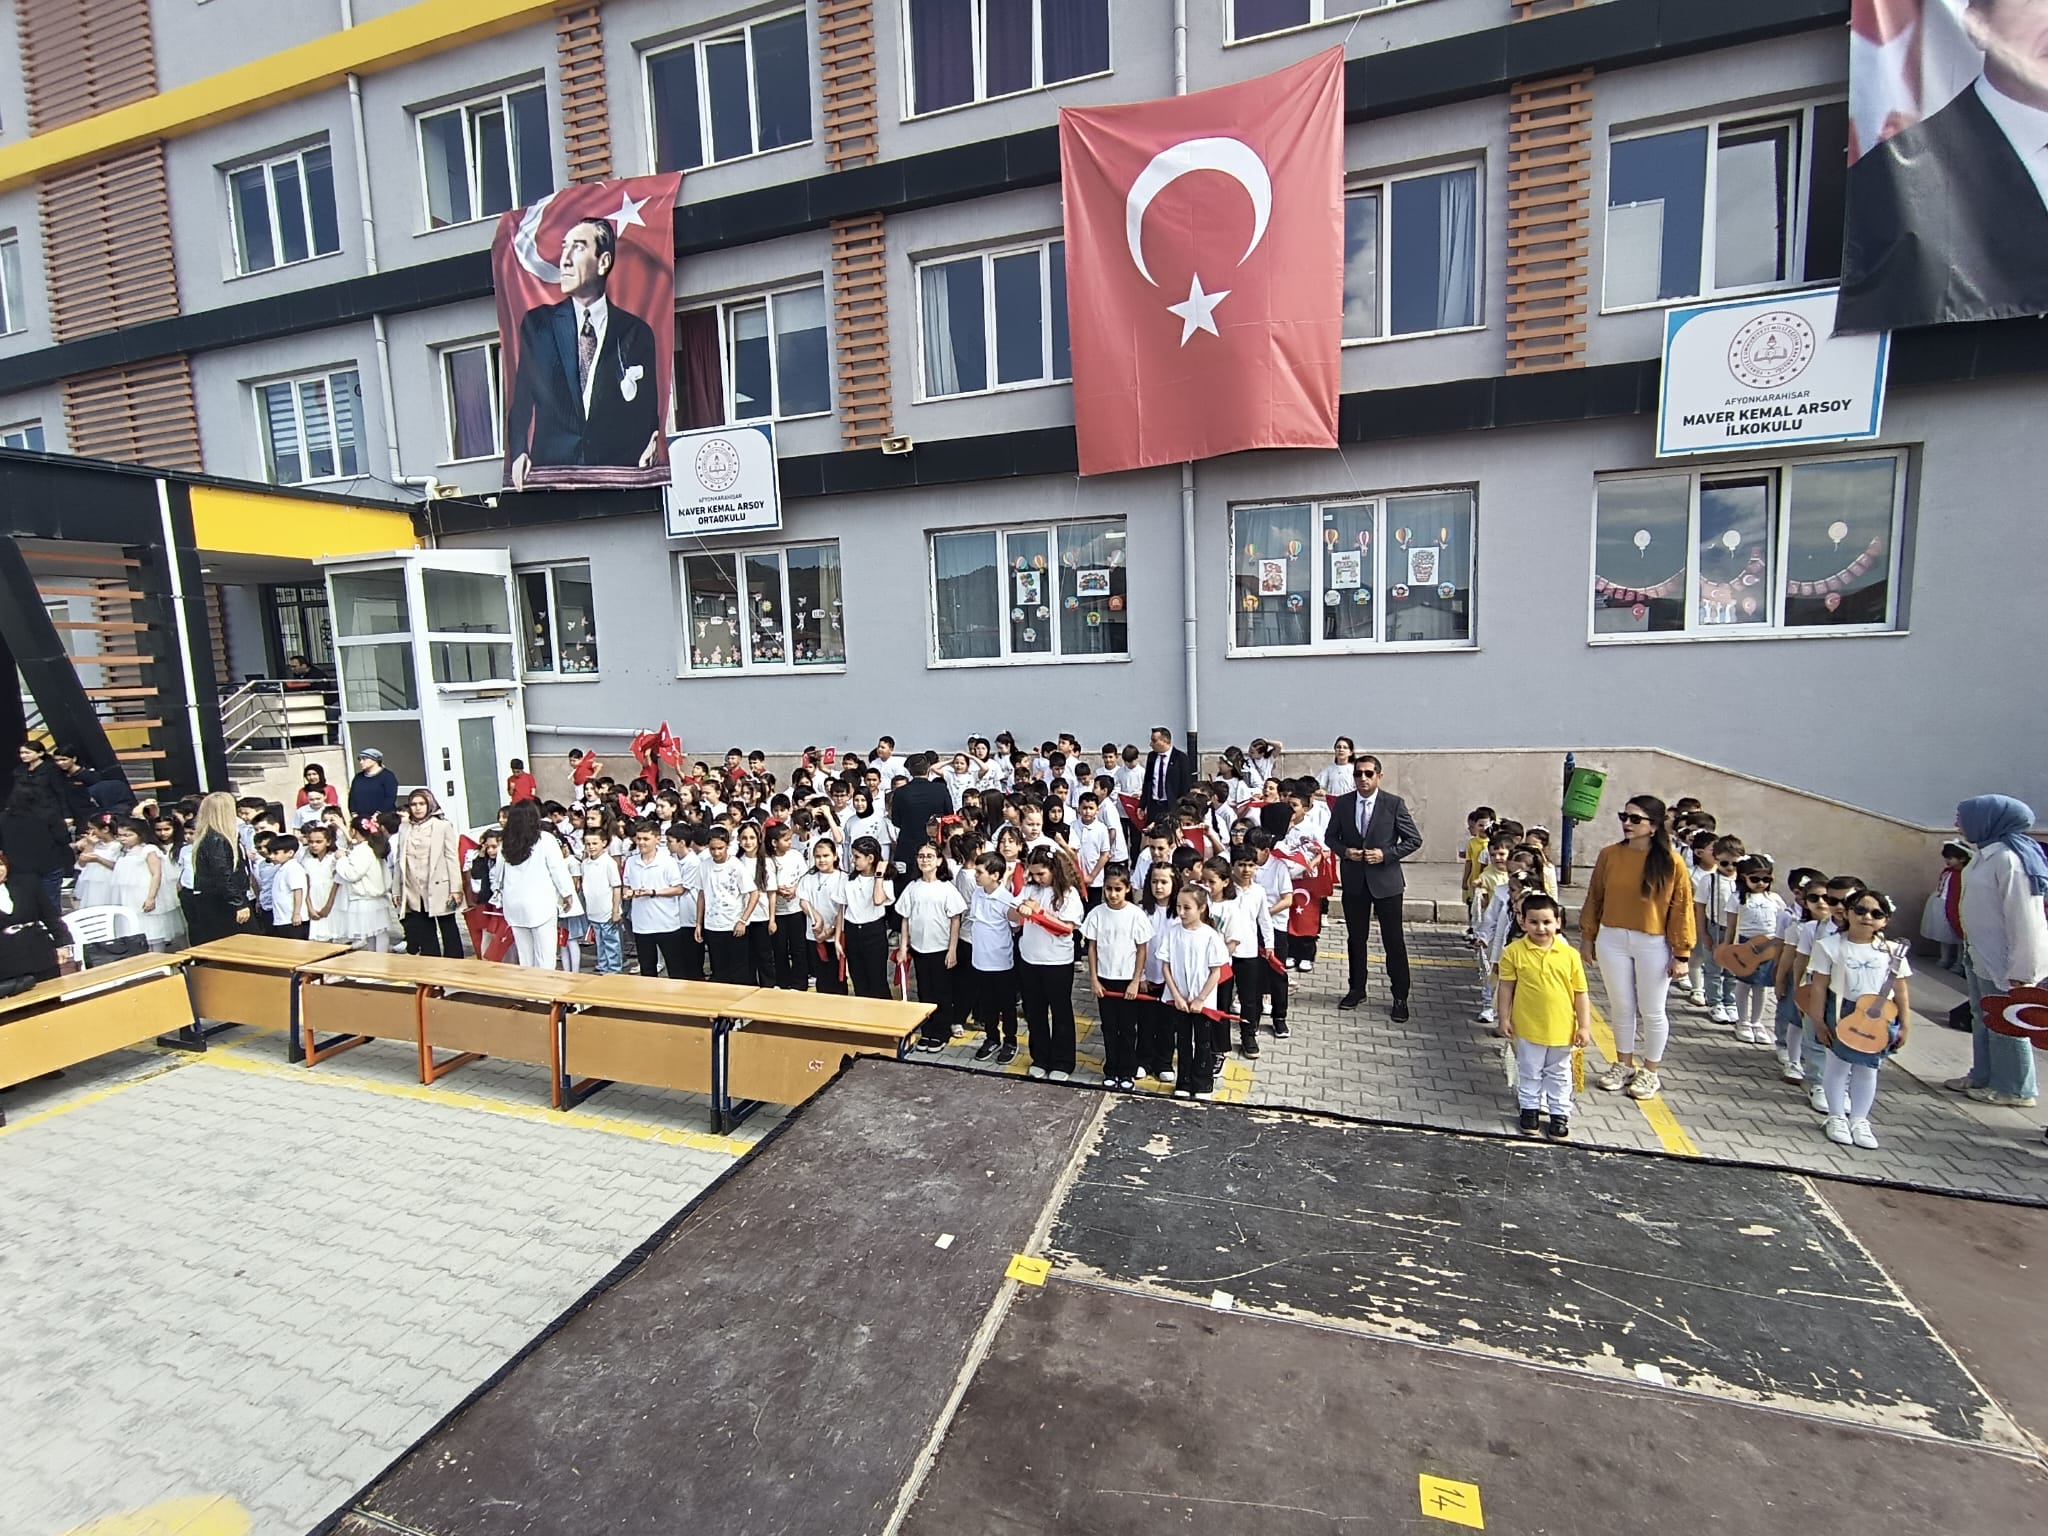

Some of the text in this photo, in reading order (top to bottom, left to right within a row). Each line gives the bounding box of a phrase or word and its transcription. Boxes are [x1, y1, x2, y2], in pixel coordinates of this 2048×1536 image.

[1725, 390, 1810, 406] AFYONKARAHİSAR
[1683, 399, 1852, 427] MAVER KEMAL ARSOY
[1726, 419, 1803, 437] İLKOKULU
[678, 500, 764, 517] MAVER KEMAL ARSOY
[698, 512, 746, 525] ORTAOKULU
